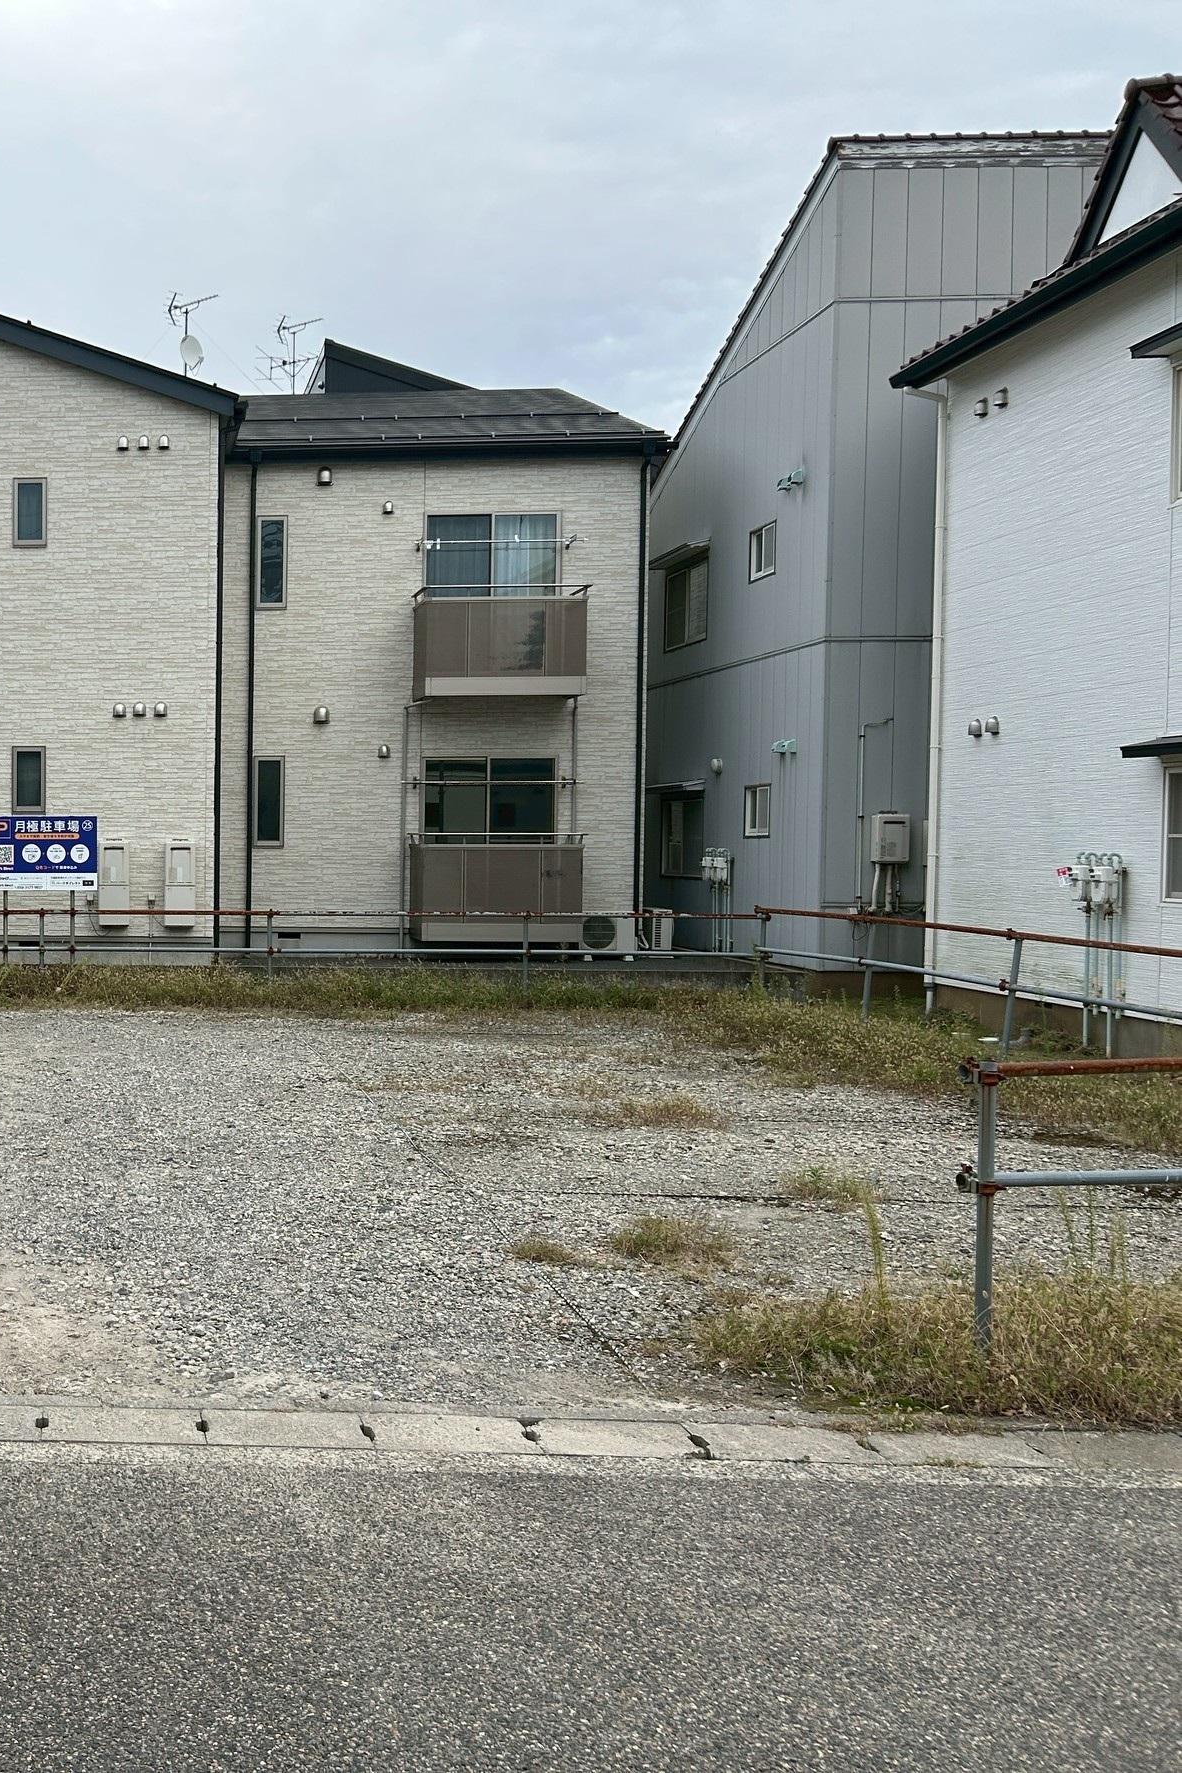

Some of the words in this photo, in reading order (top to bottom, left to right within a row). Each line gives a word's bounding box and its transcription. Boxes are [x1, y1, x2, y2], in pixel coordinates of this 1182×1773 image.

[14, 820, 80, 832] 月極駐車場
